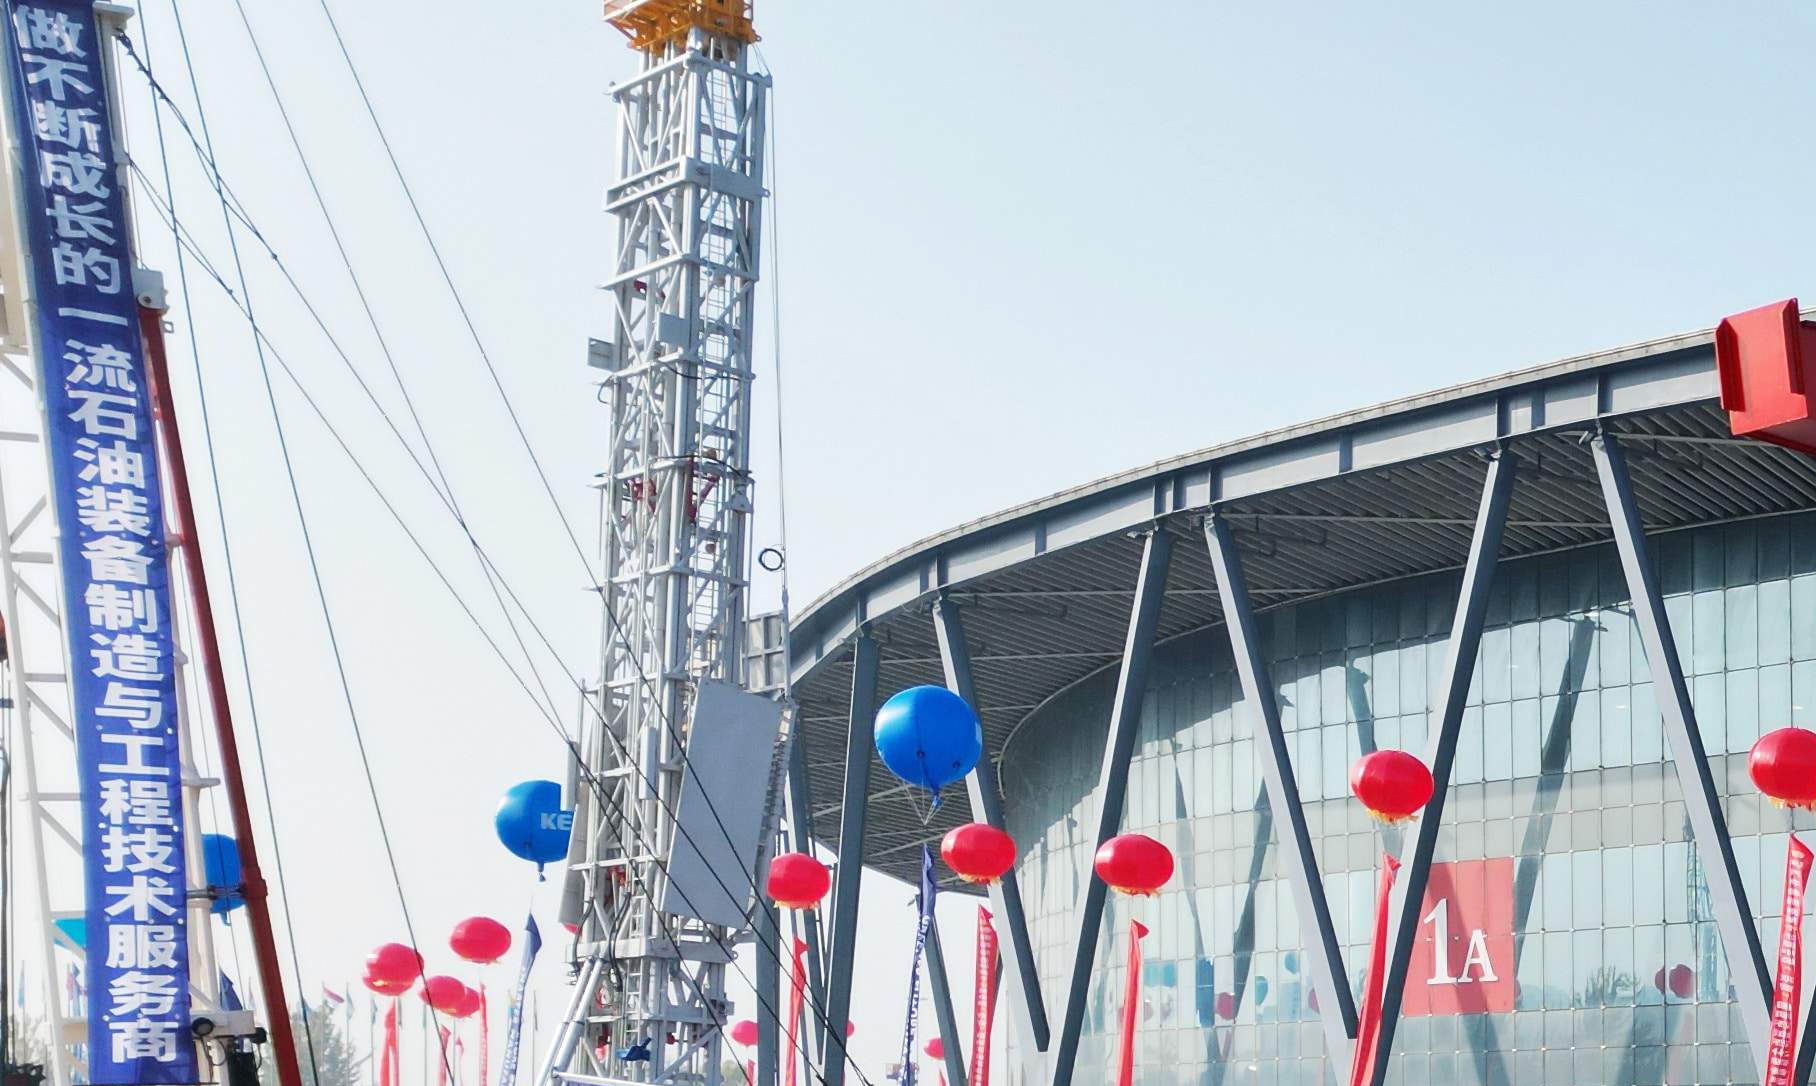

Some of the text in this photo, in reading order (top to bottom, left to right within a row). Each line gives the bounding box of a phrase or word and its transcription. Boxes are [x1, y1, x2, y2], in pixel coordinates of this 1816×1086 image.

[13, 6, 178, 1064] 做不断成长的一流石油装备制造与工程技术服务商
[1423, 898, 1499, 985] 1A
